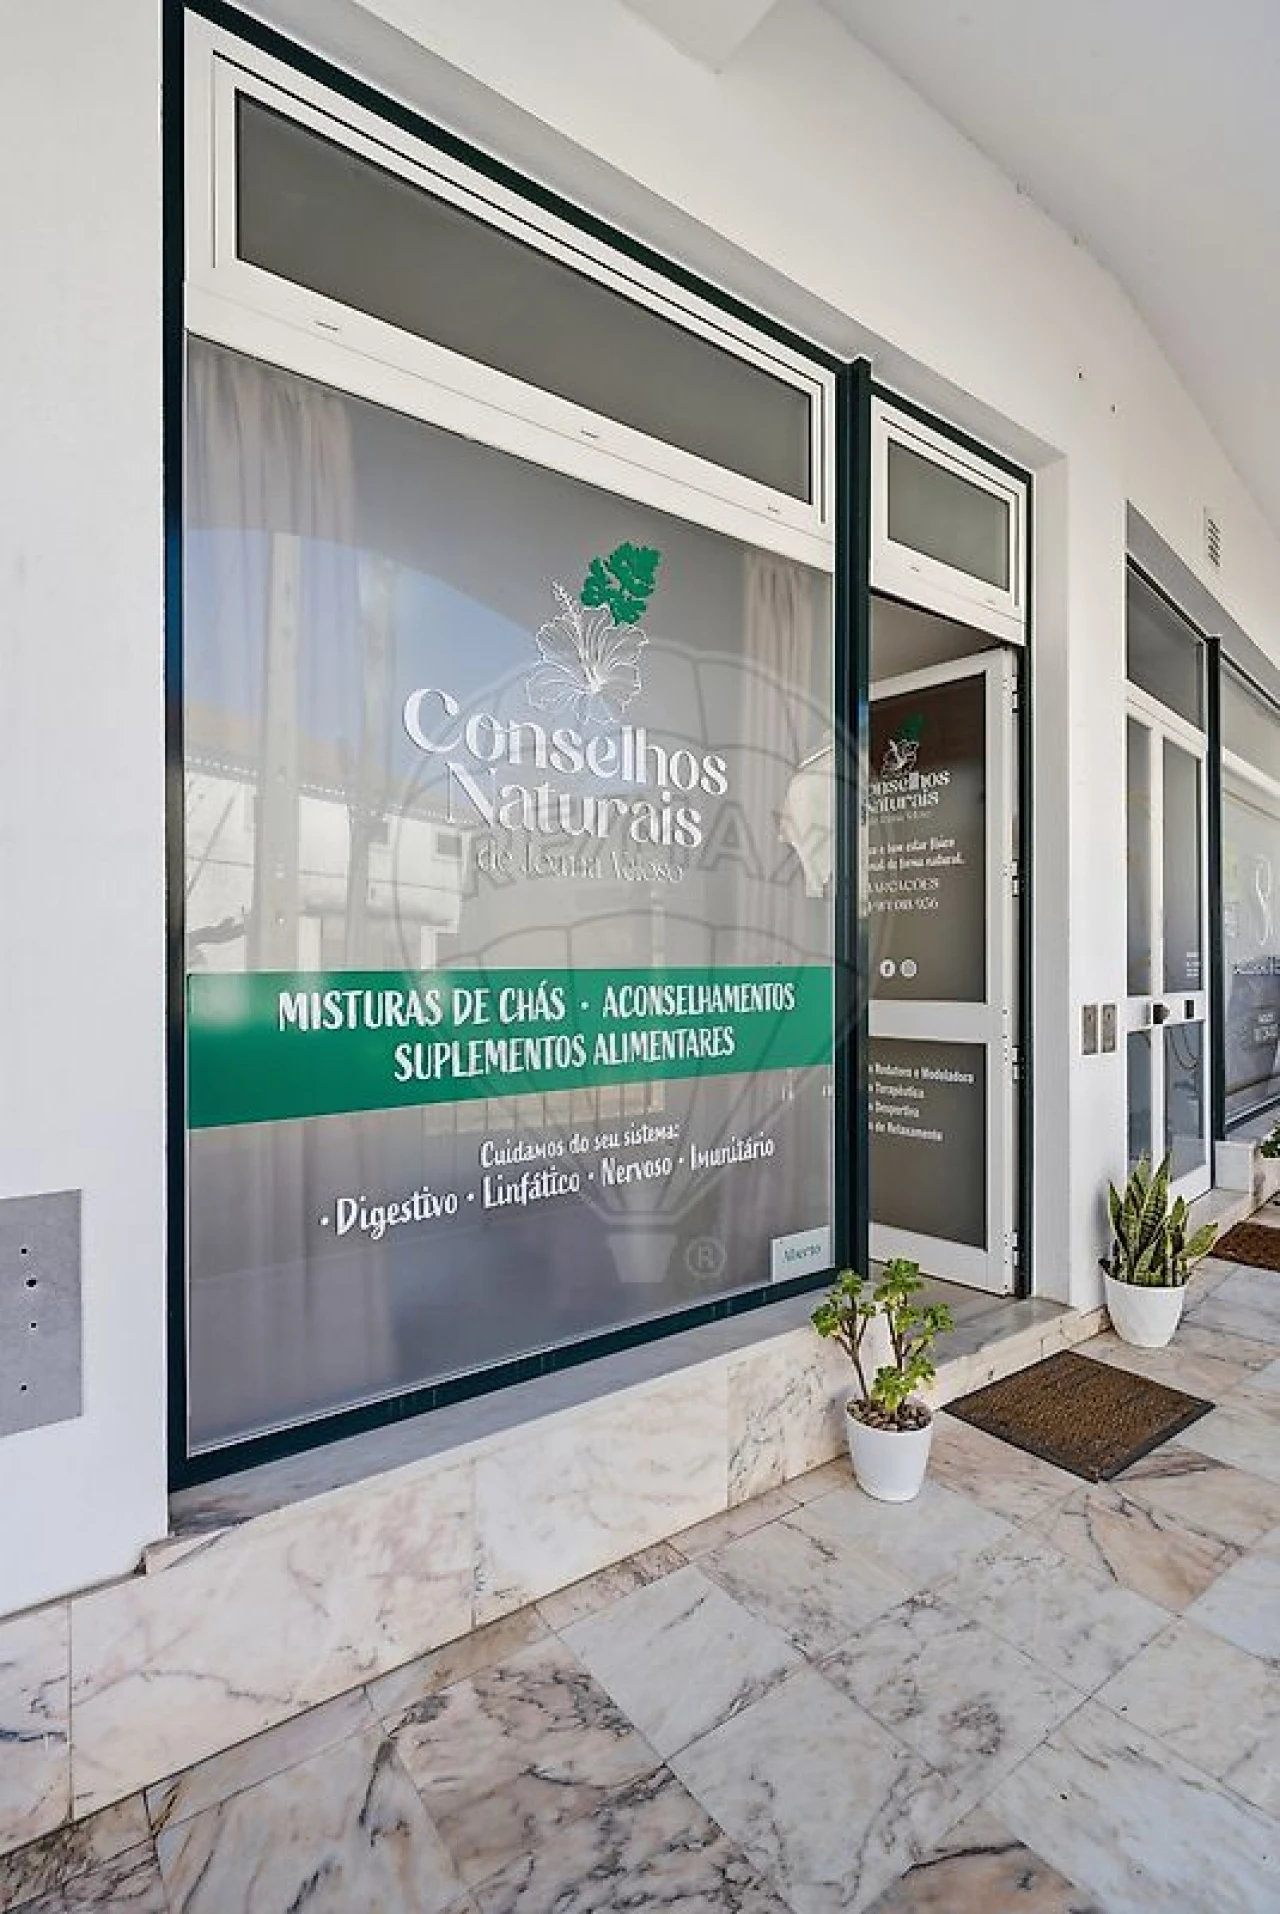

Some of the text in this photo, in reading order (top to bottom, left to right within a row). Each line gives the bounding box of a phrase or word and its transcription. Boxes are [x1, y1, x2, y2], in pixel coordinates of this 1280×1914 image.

[402, 687, 729, 796] Conselhos
[446, 760, 703, 848] Naturais
[868, 770, 951, 796] onselhos
[279, 980, 796, 1032] MISTURAS DE CHÁS ACONSELHAMENTOS
[394, 1025, 736, 1082] SUPLEMENTOS ALIMENTARES
[480, 1121, 680, 1169] Cuidamos do seu sistema:
[336, 1130, 775, 1241] Digestivo Linfático Nervoso Imunitário
